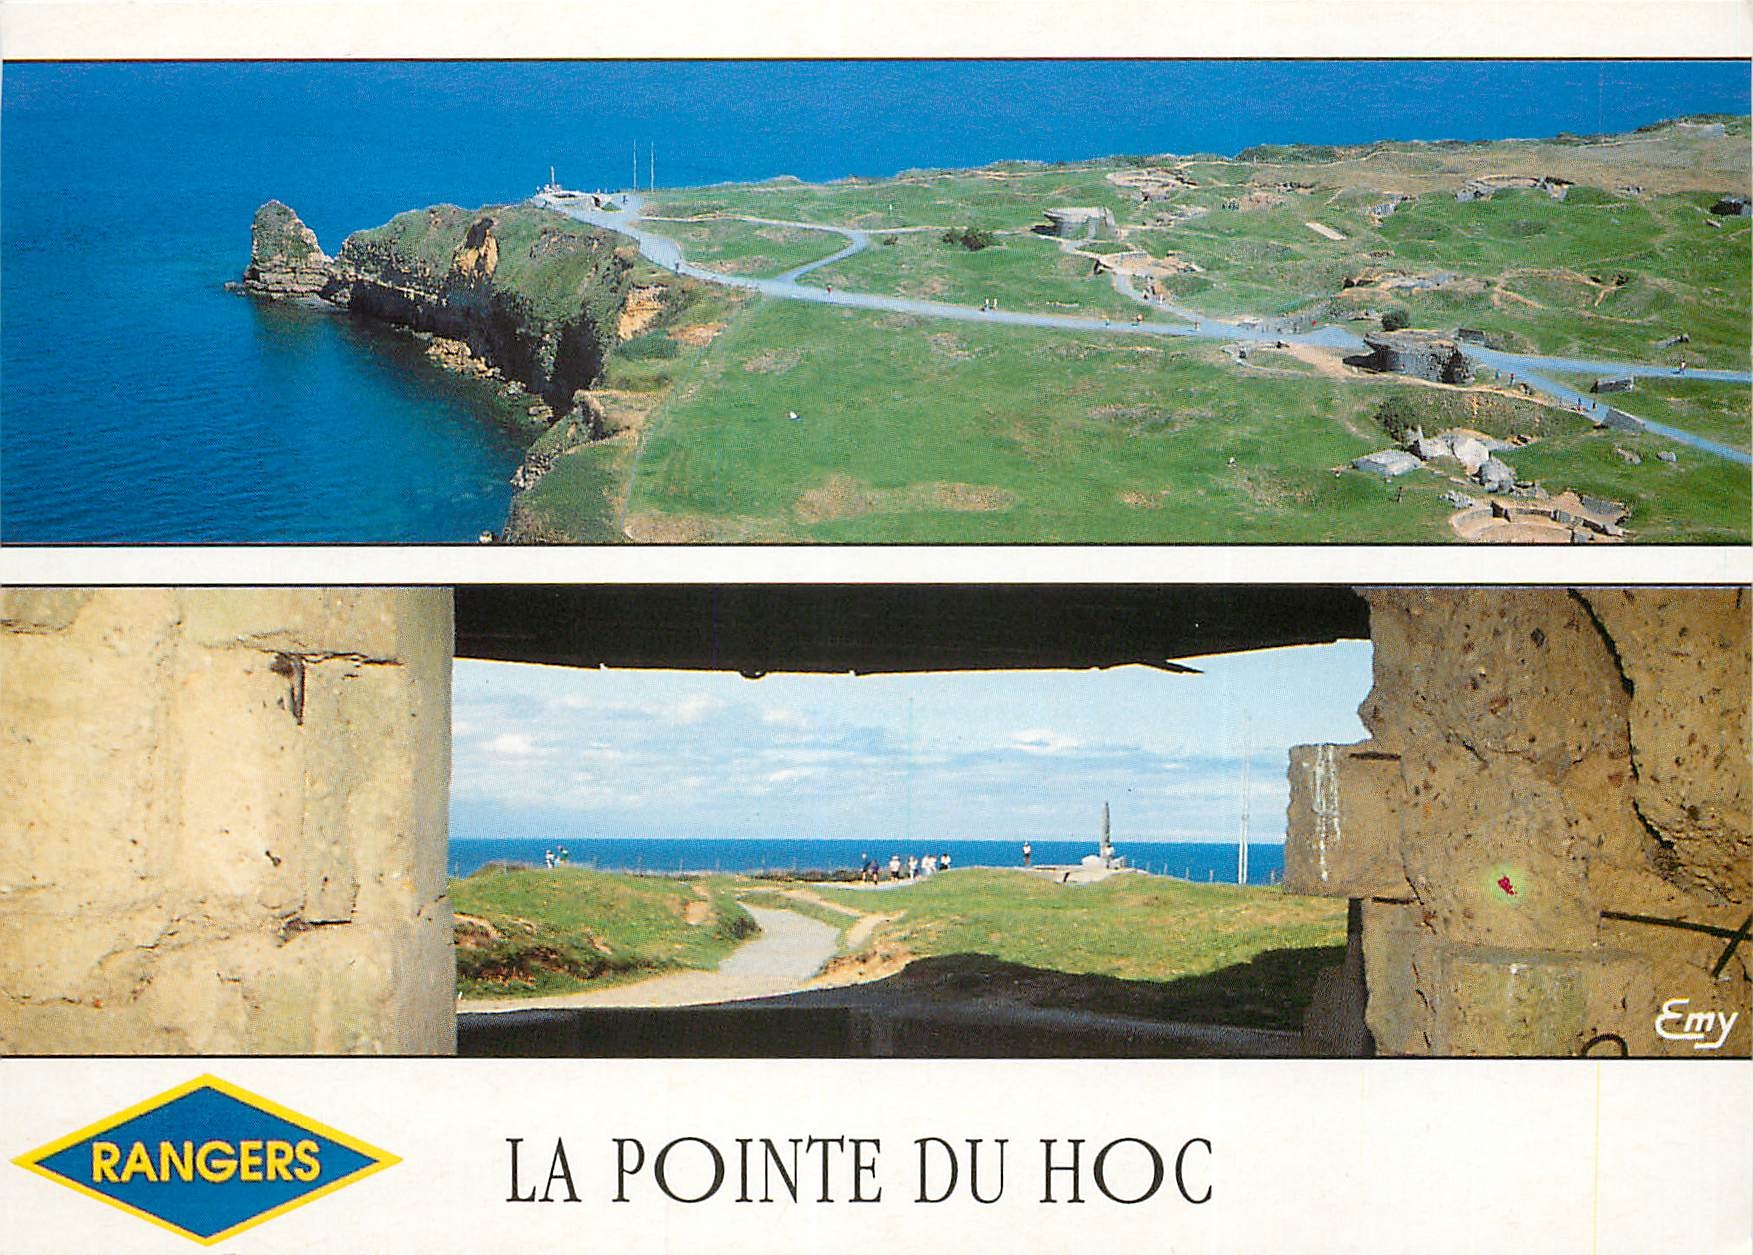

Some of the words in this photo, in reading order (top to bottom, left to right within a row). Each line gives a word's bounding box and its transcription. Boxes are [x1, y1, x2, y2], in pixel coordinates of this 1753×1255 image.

[91, 1140, 322, 1183] RANGERS
[505, 1137, 582, 1204] LA
[611, 1135, 882, 1205] POINTE
[914, 1137, 1009, 1205] DU
[1039, 1137, 1213, 1206] HOC
